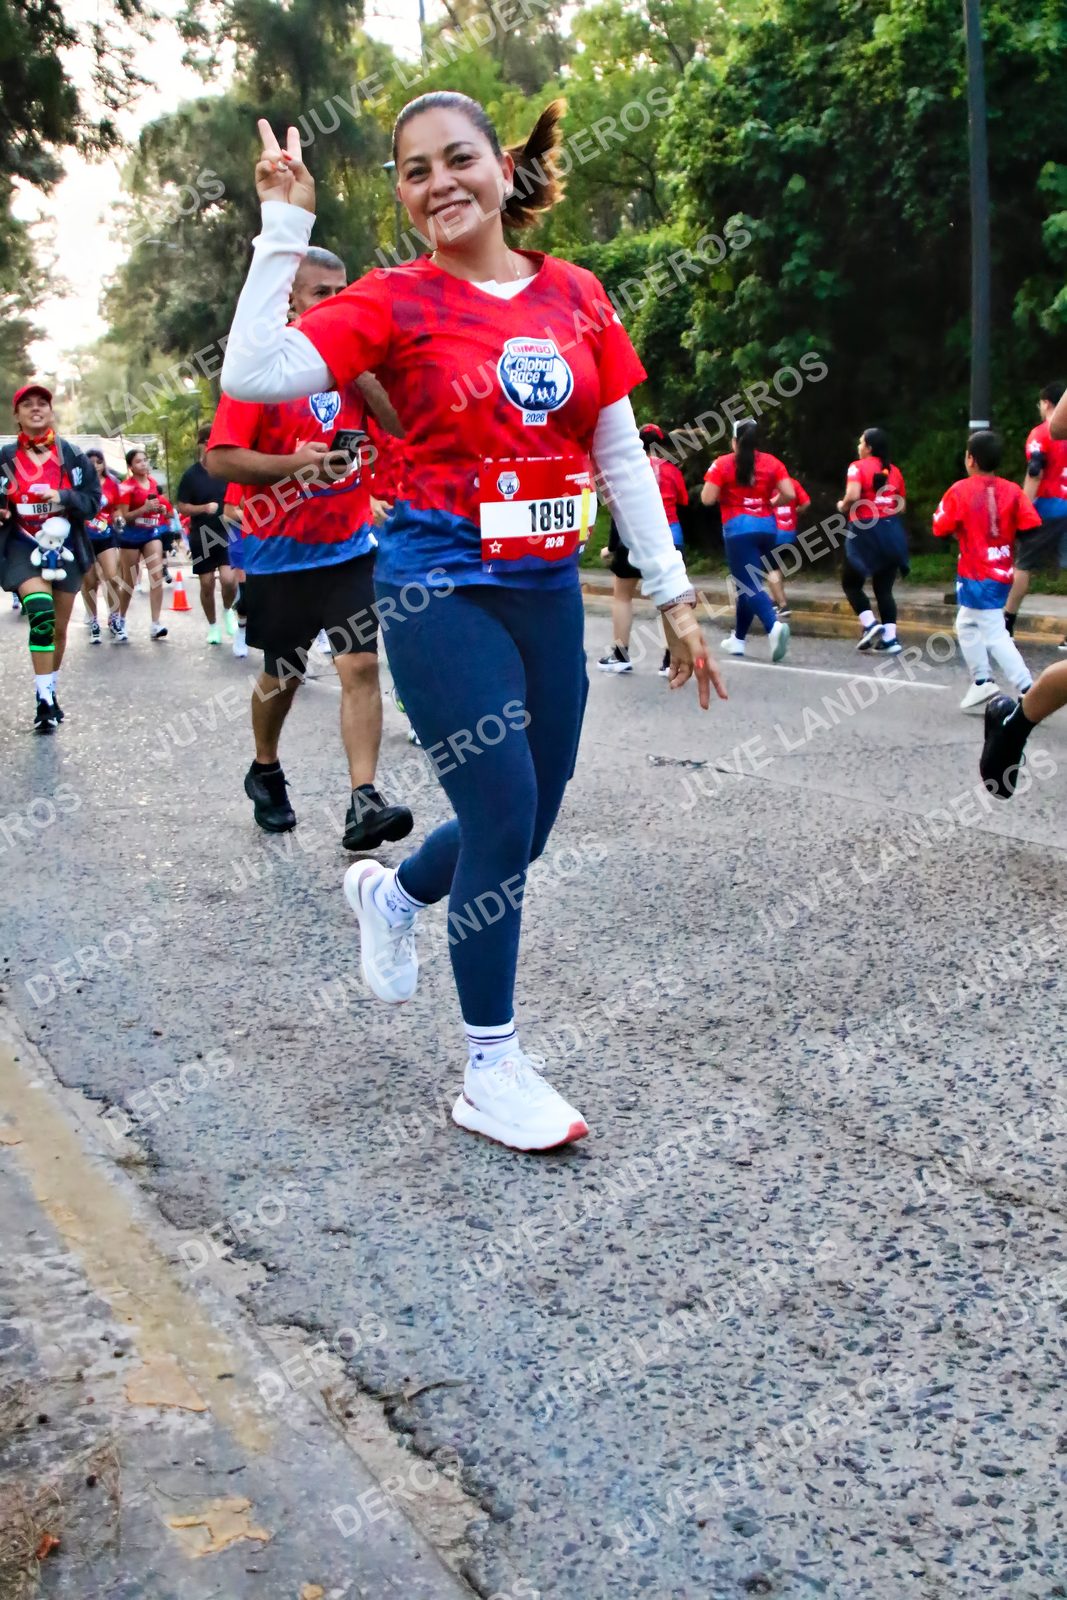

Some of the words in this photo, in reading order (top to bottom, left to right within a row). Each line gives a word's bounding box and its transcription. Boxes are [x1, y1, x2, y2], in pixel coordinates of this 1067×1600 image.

[515, 357, 554, 373] Global
[509, 371, 541, 383] Race
[525, 413, 546, 423] 2026
[32, 503, 53, 514] 1867
[528, 499, 575, 532] 1899
